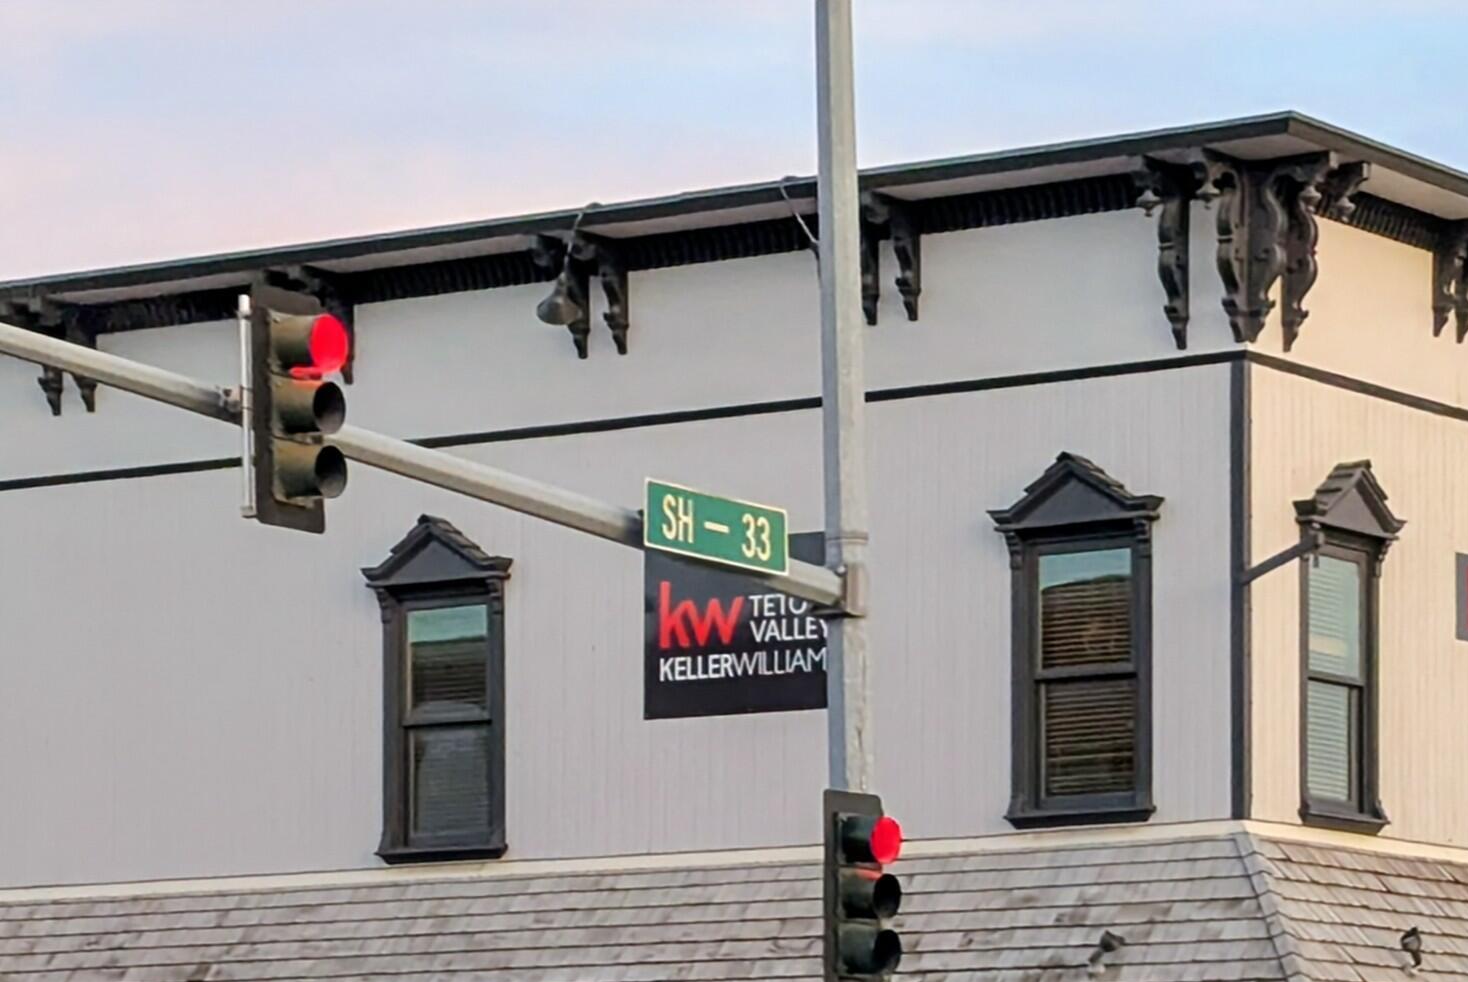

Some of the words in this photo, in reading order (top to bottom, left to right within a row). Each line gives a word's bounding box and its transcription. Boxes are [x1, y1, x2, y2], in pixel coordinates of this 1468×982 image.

[661, 494, 694, 544] SH
[741, 513, 771, 561] 33
[658, 580, 745, 649] kw
[748, 593, 812, 617] TETO
[658, 647, 827, 682] KELLERWILLIAM
